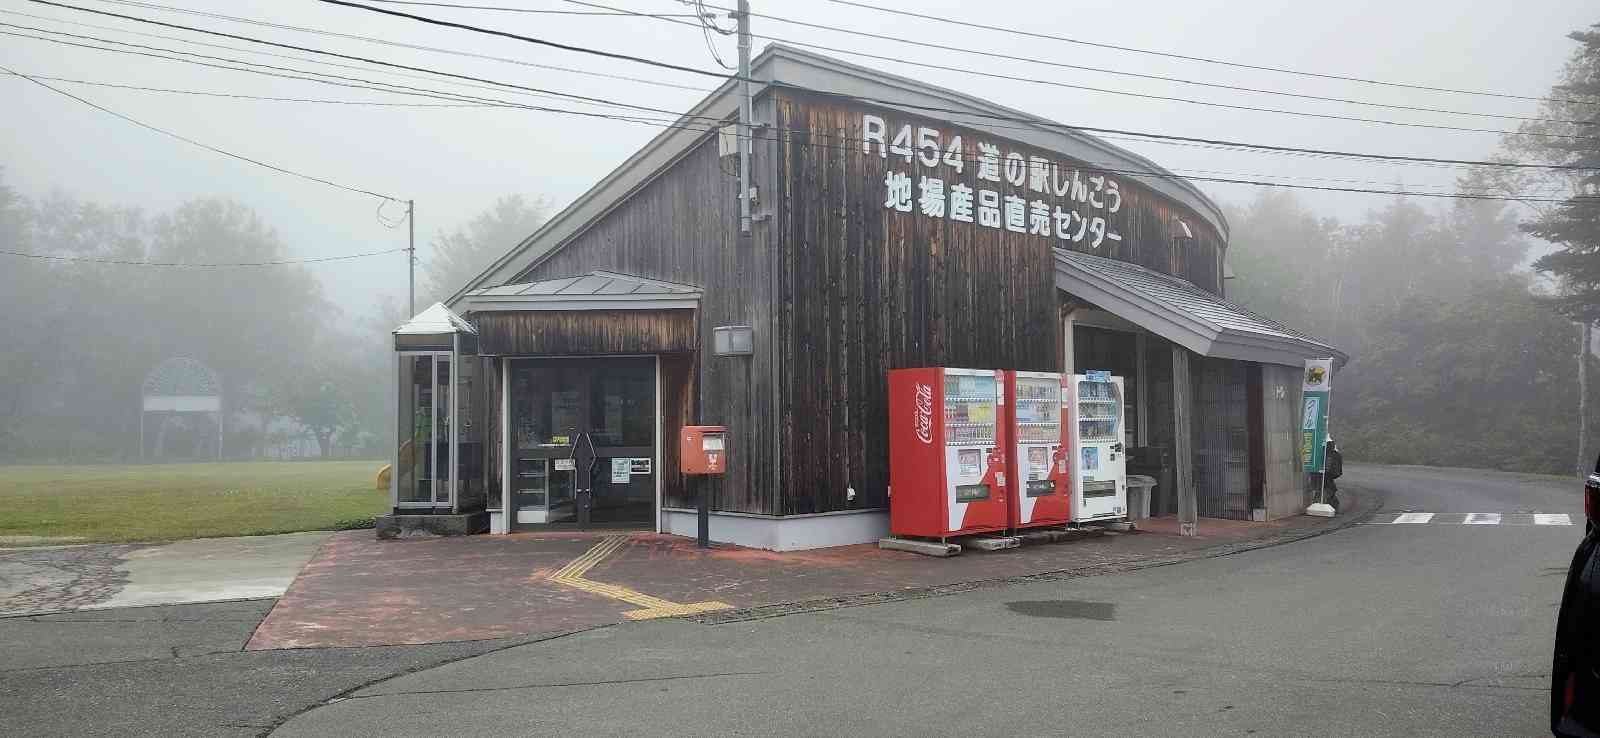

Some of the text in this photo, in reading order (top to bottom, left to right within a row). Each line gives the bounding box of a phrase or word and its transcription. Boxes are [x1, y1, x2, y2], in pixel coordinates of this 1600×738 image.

[863, 114, 964, 174] R454
[884, 171, 1122, 248] 地場産品直売センター
